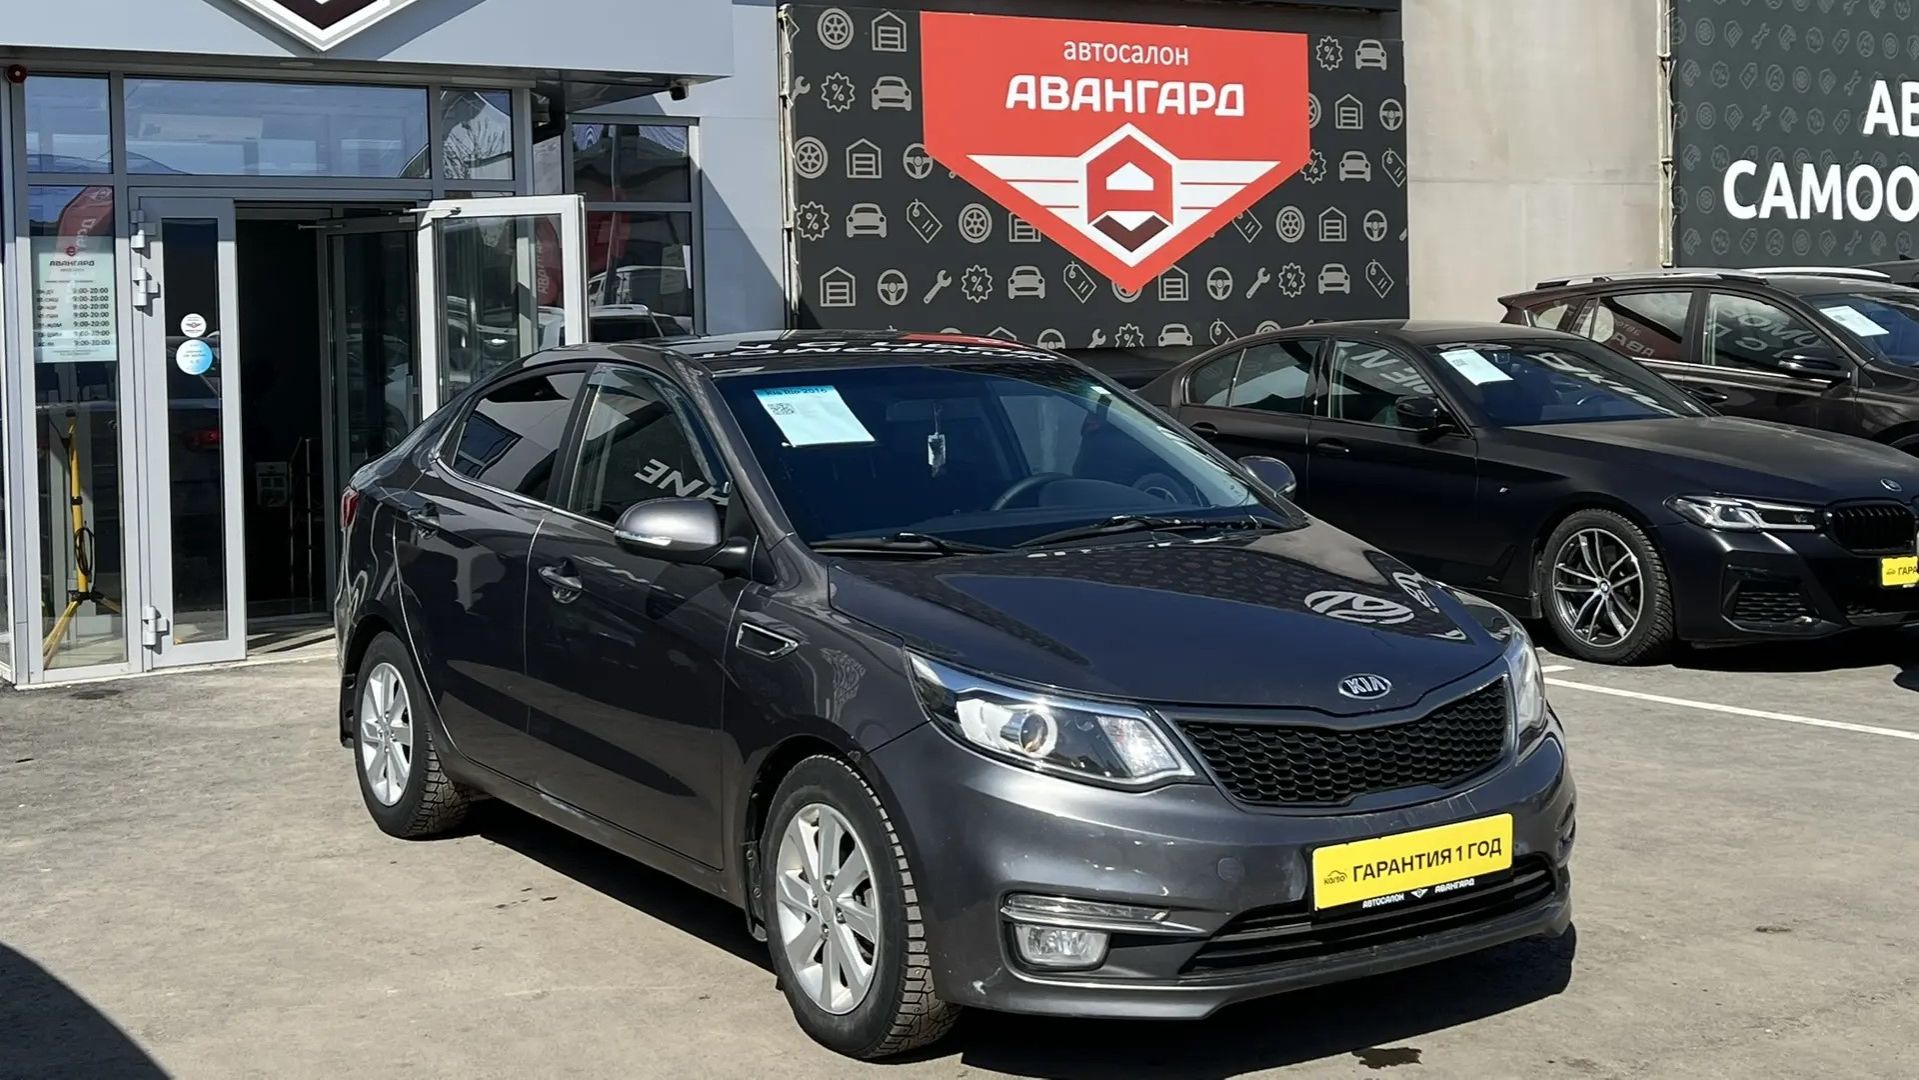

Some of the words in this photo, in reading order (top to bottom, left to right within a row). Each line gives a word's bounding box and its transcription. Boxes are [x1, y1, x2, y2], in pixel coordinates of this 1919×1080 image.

[1063, 40, 1189, 66] автосалон
[1005, 74, 1245, 117] АВАНГАРД
[1344, 676, 1387, 695] KIA
[1352, 847, 1451, 883] ГАРАНТИЯ
[1455, 845, 1463, 862] 1
[1467, 837, 1502, 860] ГОД
[1362, 893, 1405, 909] АВТОСАЛОН
[1434, 877, 1475, 894] АВАНГАРД
